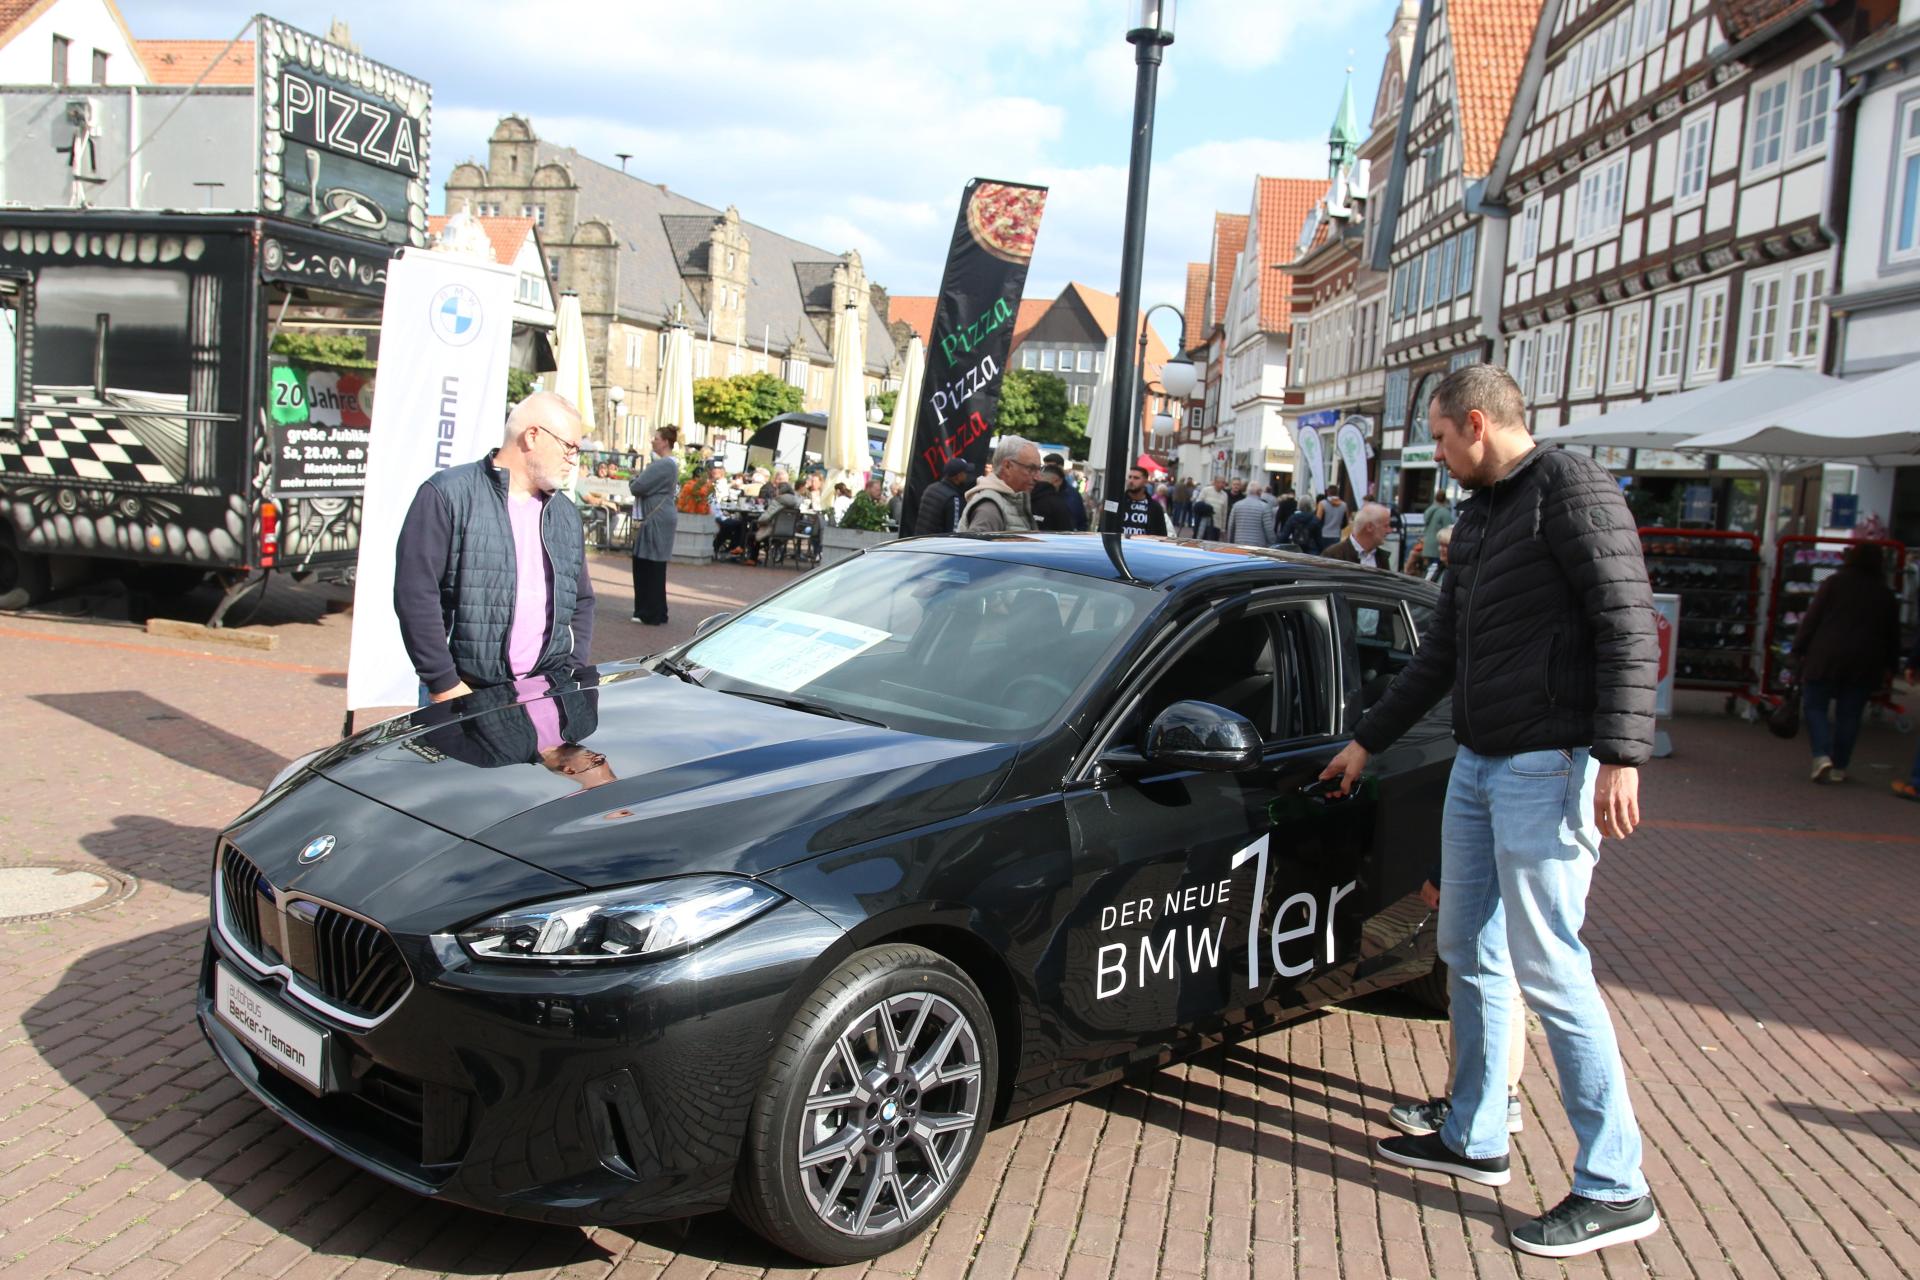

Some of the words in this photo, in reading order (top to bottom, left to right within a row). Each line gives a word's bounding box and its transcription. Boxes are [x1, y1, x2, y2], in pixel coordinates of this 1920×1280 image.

[284, 73, 419, 173] PIZZA
[940, 296, 1013, 368] Pizza
[276, 383, 303, 407] 20
[310, 386, 356, 411] Jahre
[929, 354, 1000, 426] Pizza
[283, 446, 302, 461] Sa,
[304, 446, 341, 460] 28.09.
[346, 447, 364, 460] ab
[287, 428, 327, 444] große
[923, 410, 988, 480] Pizza
[280, 477, 305, 489] mehr
[306, 477, 332, 488] unter
[304, 463, 357, 477] Marktplatz
[1096, 916, 1227, 1000] BMW
[1231, 832, 1357, 990] 1er
[1101, 897, 1154, 931] DER
[1164, 879, 1232, 916] NEUE
[228, 982, 262, 1018] autohaus
[229, 1000, 306, 1068] Becker-Tiemann
